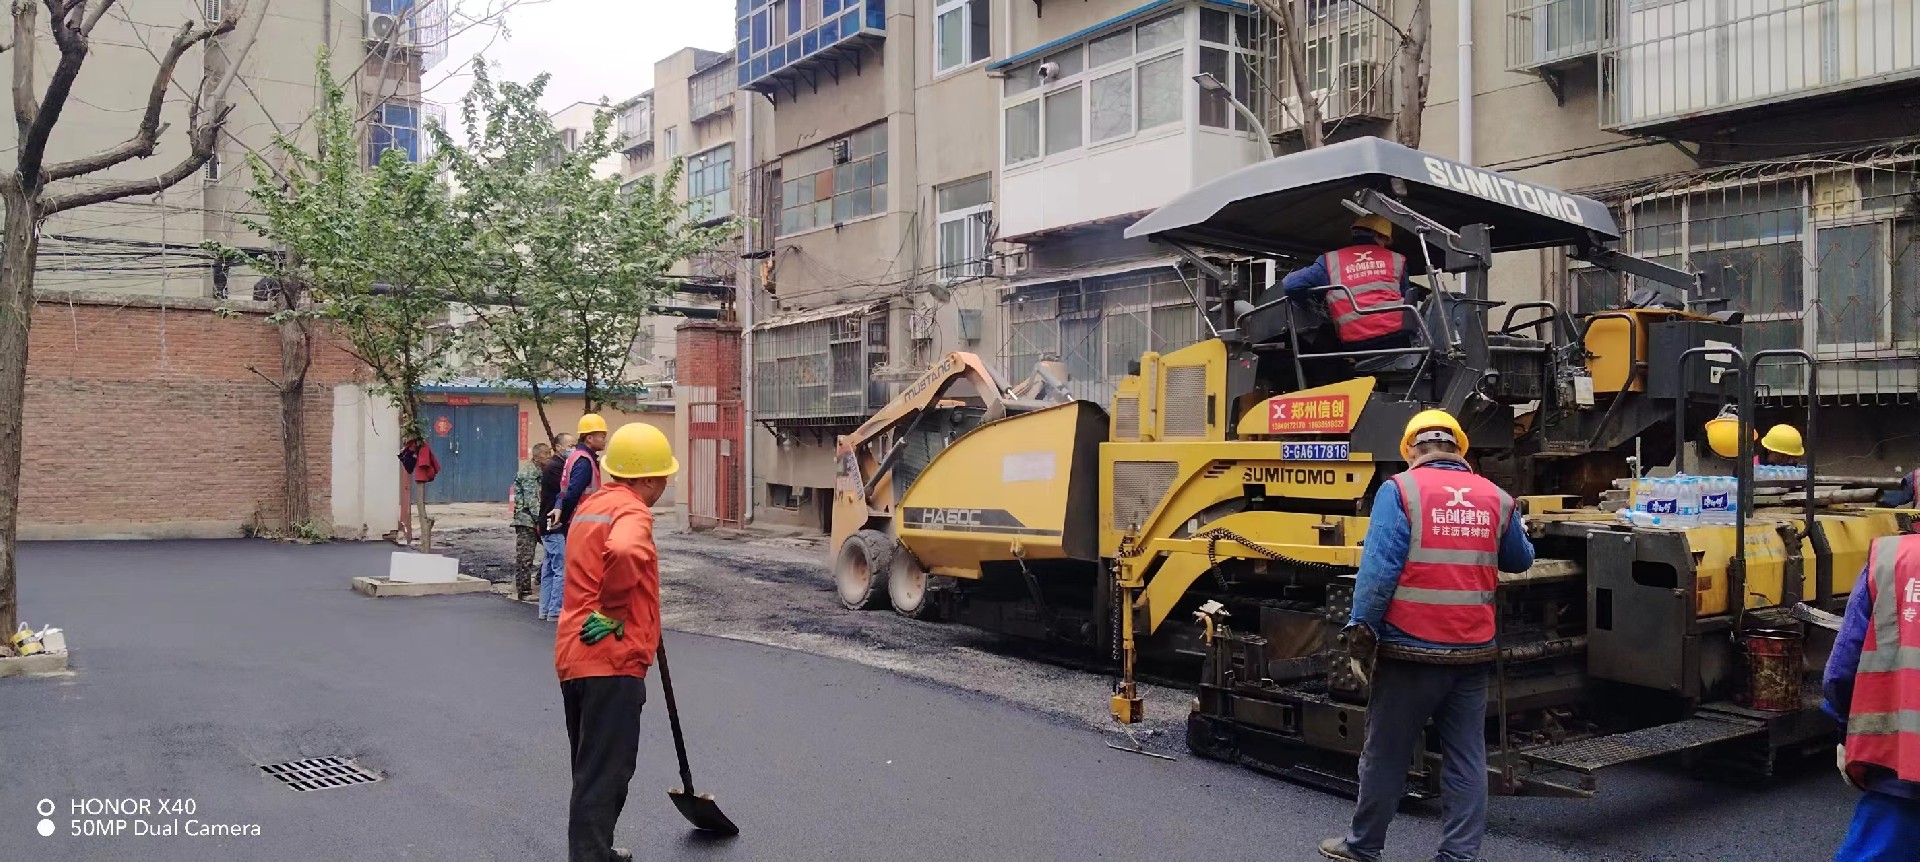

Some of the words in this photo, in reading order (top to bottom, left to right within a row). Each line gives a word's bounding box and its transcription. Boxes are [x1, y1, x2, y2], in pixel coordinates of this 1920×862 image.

[1423, 156, 1584, 224] SUMITOMO
[904, 359, 951, 403] MUSTANG
[1291, 400, 1345, 419] 郑州信创
[1283, 444, 1347, 459] 3-GA617816
[1242, 466, 1336, 485] SUMITOMO
[922, 508, 982, 526] HA60C
[1431, 508, 1491, 526] 信创建筑
